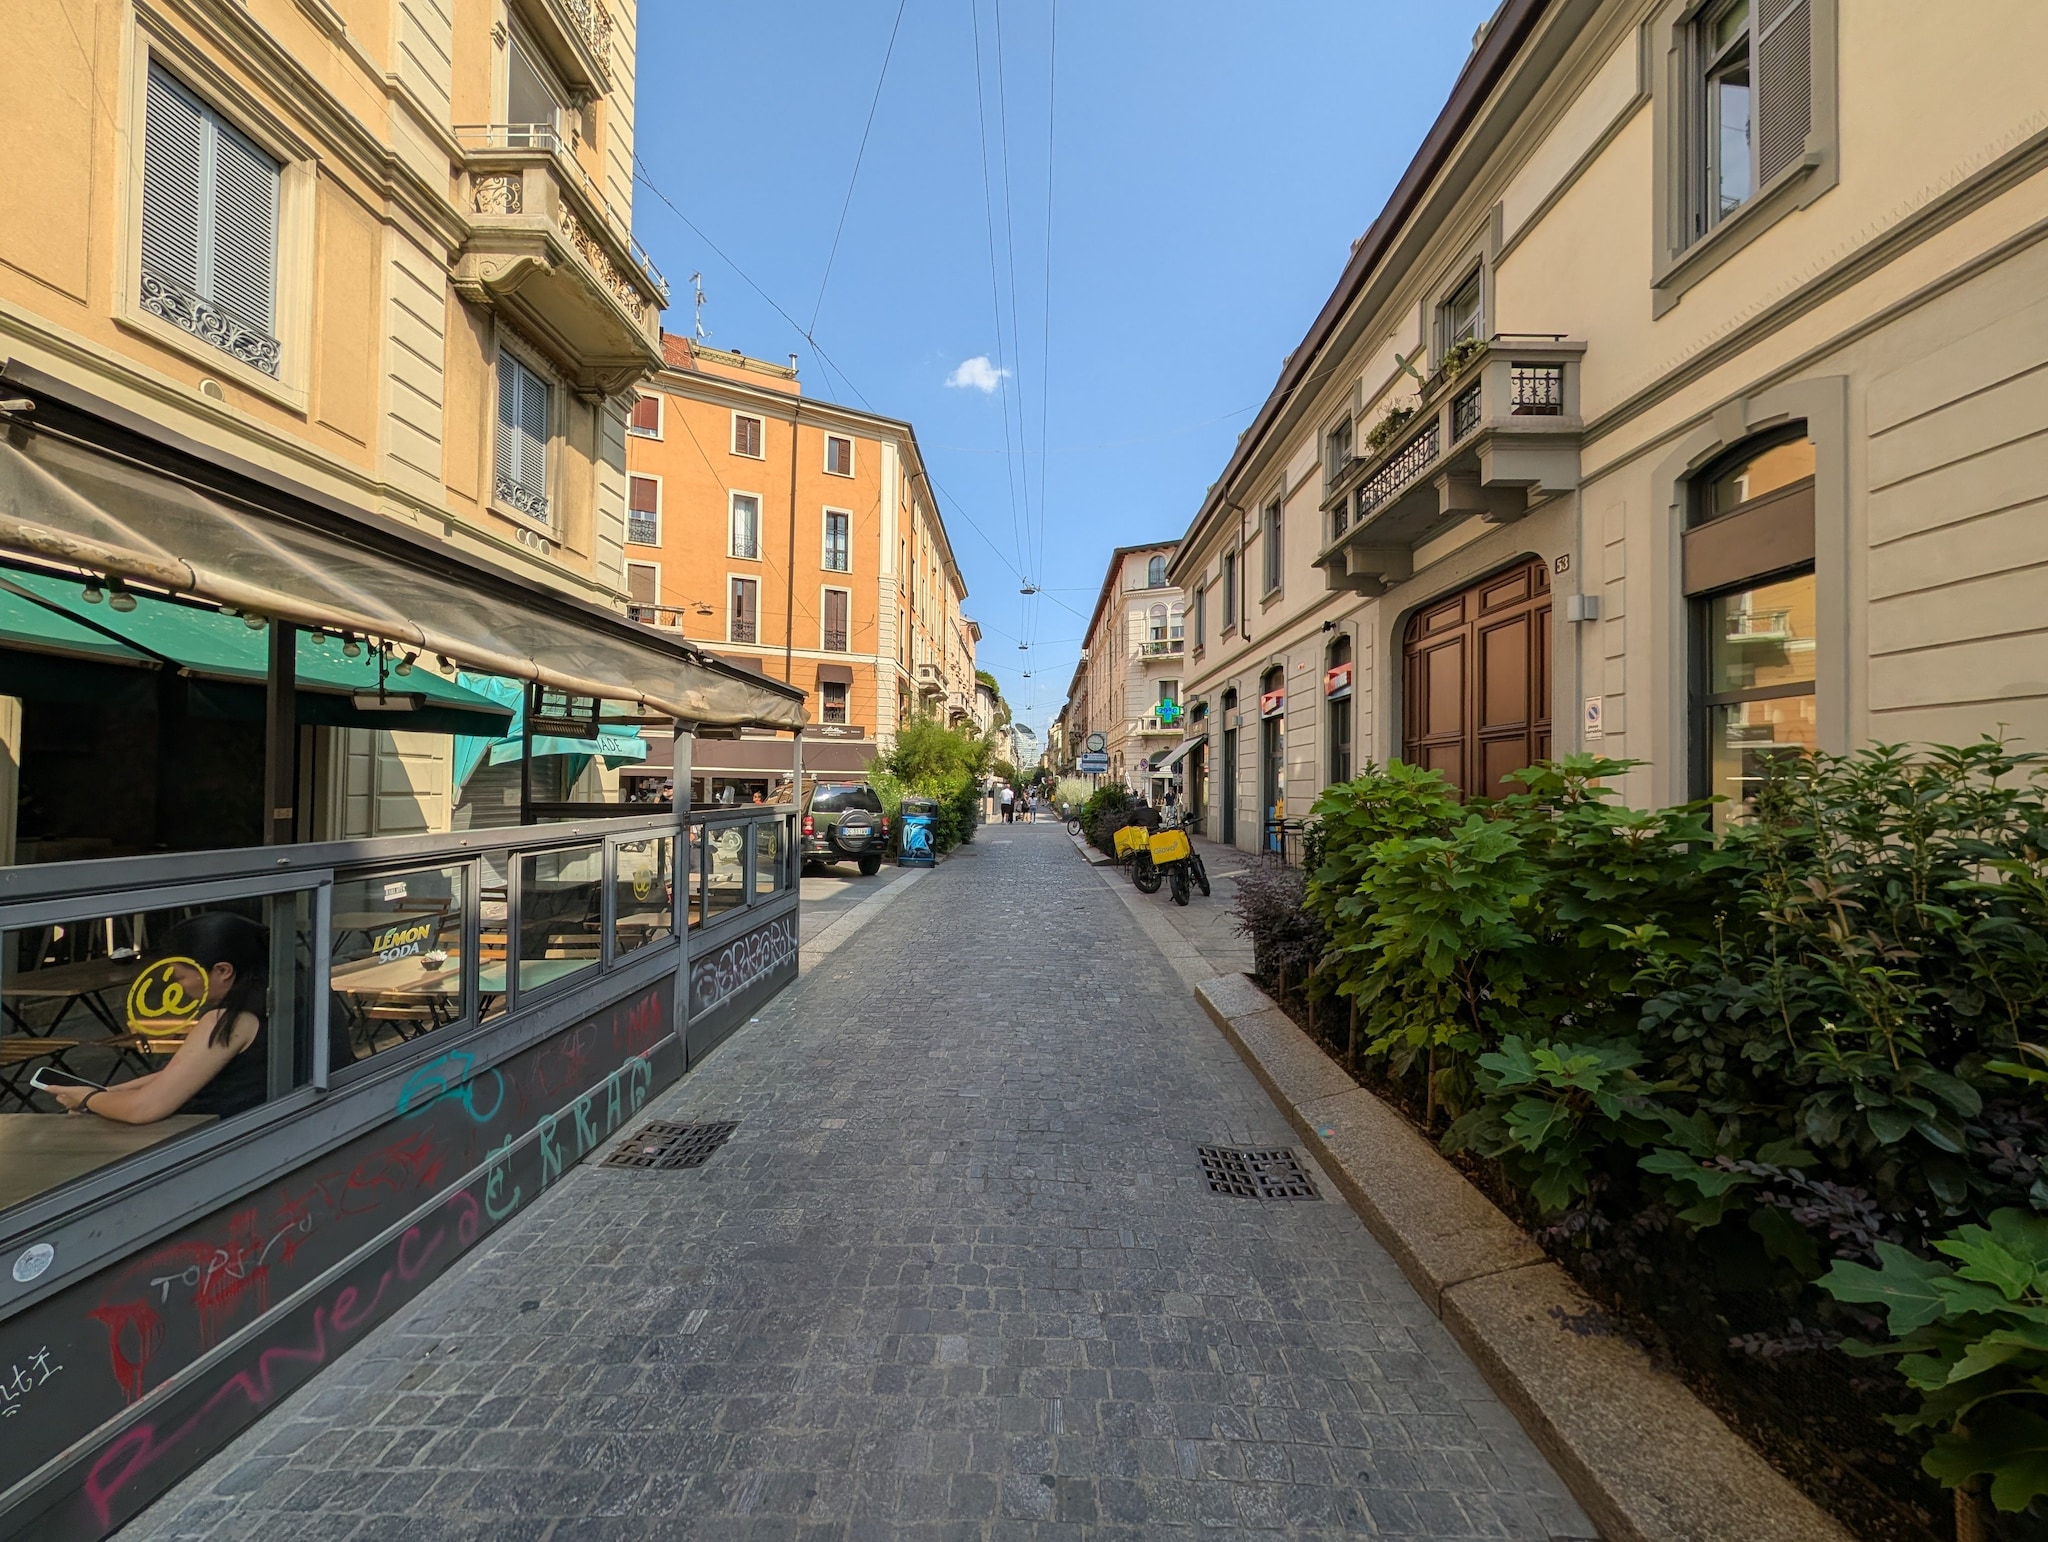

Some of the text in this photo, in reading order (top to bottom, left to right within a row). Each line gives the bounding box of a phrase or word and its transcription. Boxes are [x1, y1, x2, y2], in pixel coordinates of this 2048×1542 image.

[1556, 556, 1569, 572] 53
[372, 923, 431, 953] LEMON
[378, 942, 420, 964] SODA
